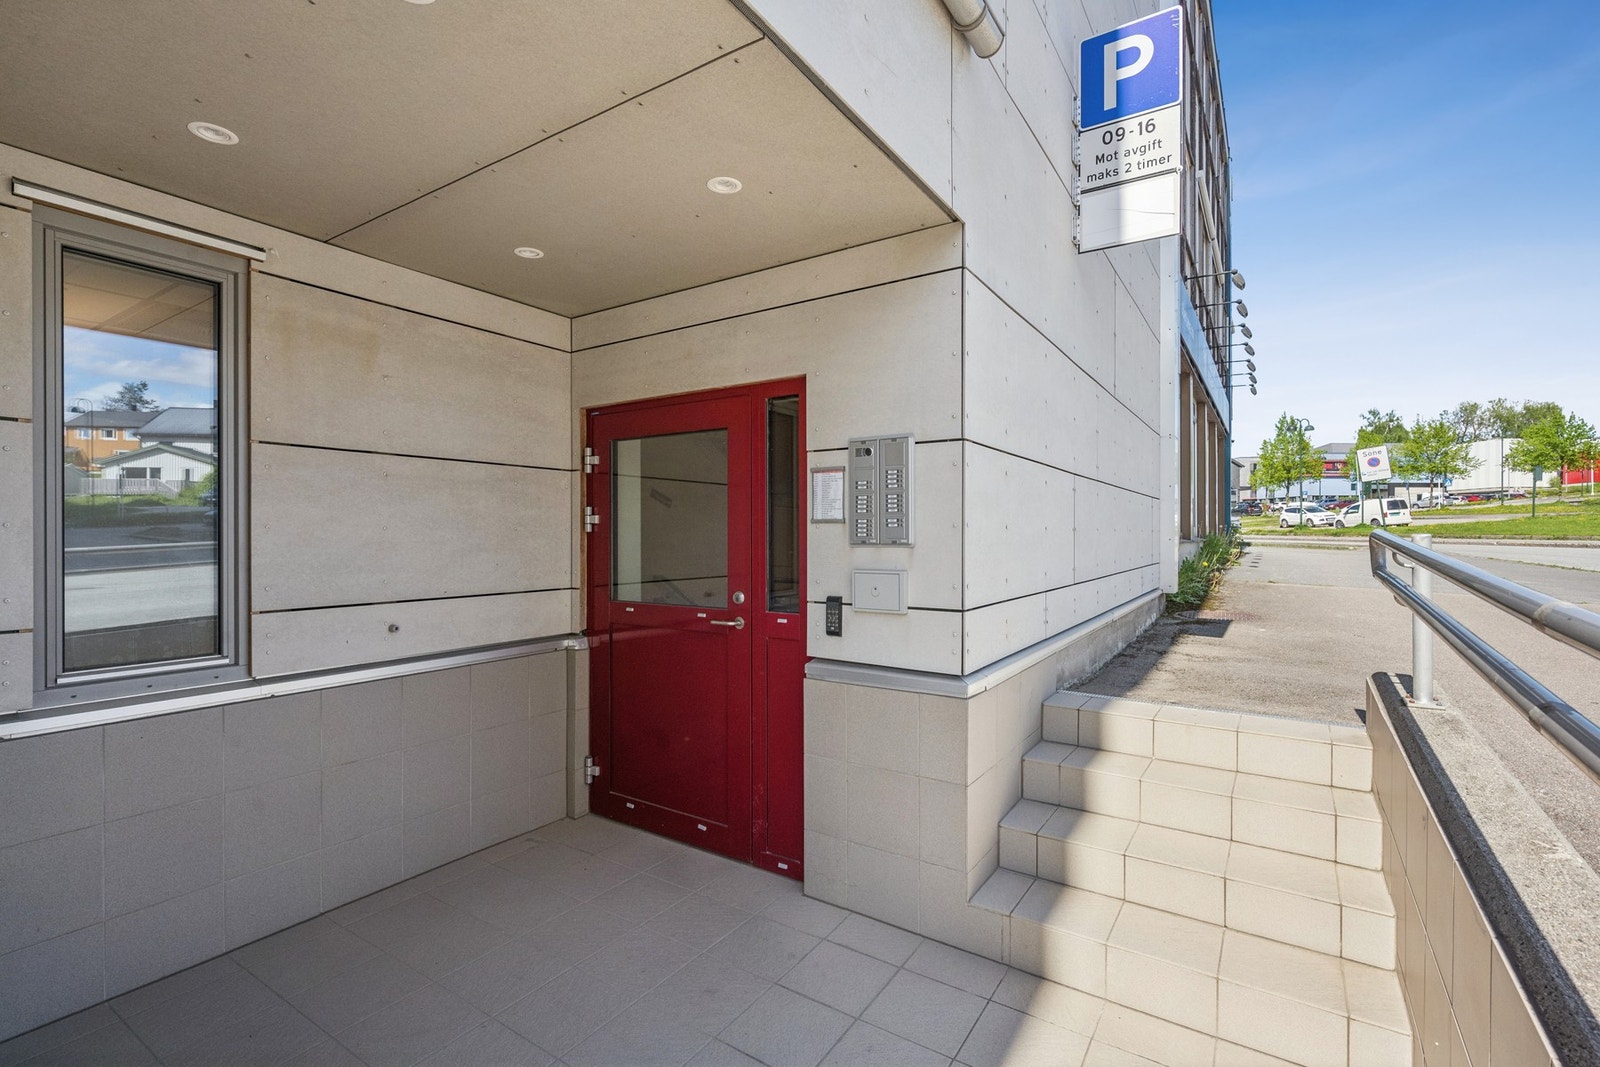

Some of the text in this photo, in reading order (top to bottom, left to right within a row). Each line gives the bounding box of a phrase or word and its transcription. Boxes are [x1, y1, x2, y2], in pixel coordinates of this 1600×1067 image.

[1103, 34, 1154, 111] P
[1102, 118, 1156, 145] 09-16
[1095, 138, 1162, 165] Mot avgift
[1086, 153, 1173, 184] maks 2 timer
[1362, 450, 1382, 458] Sone
